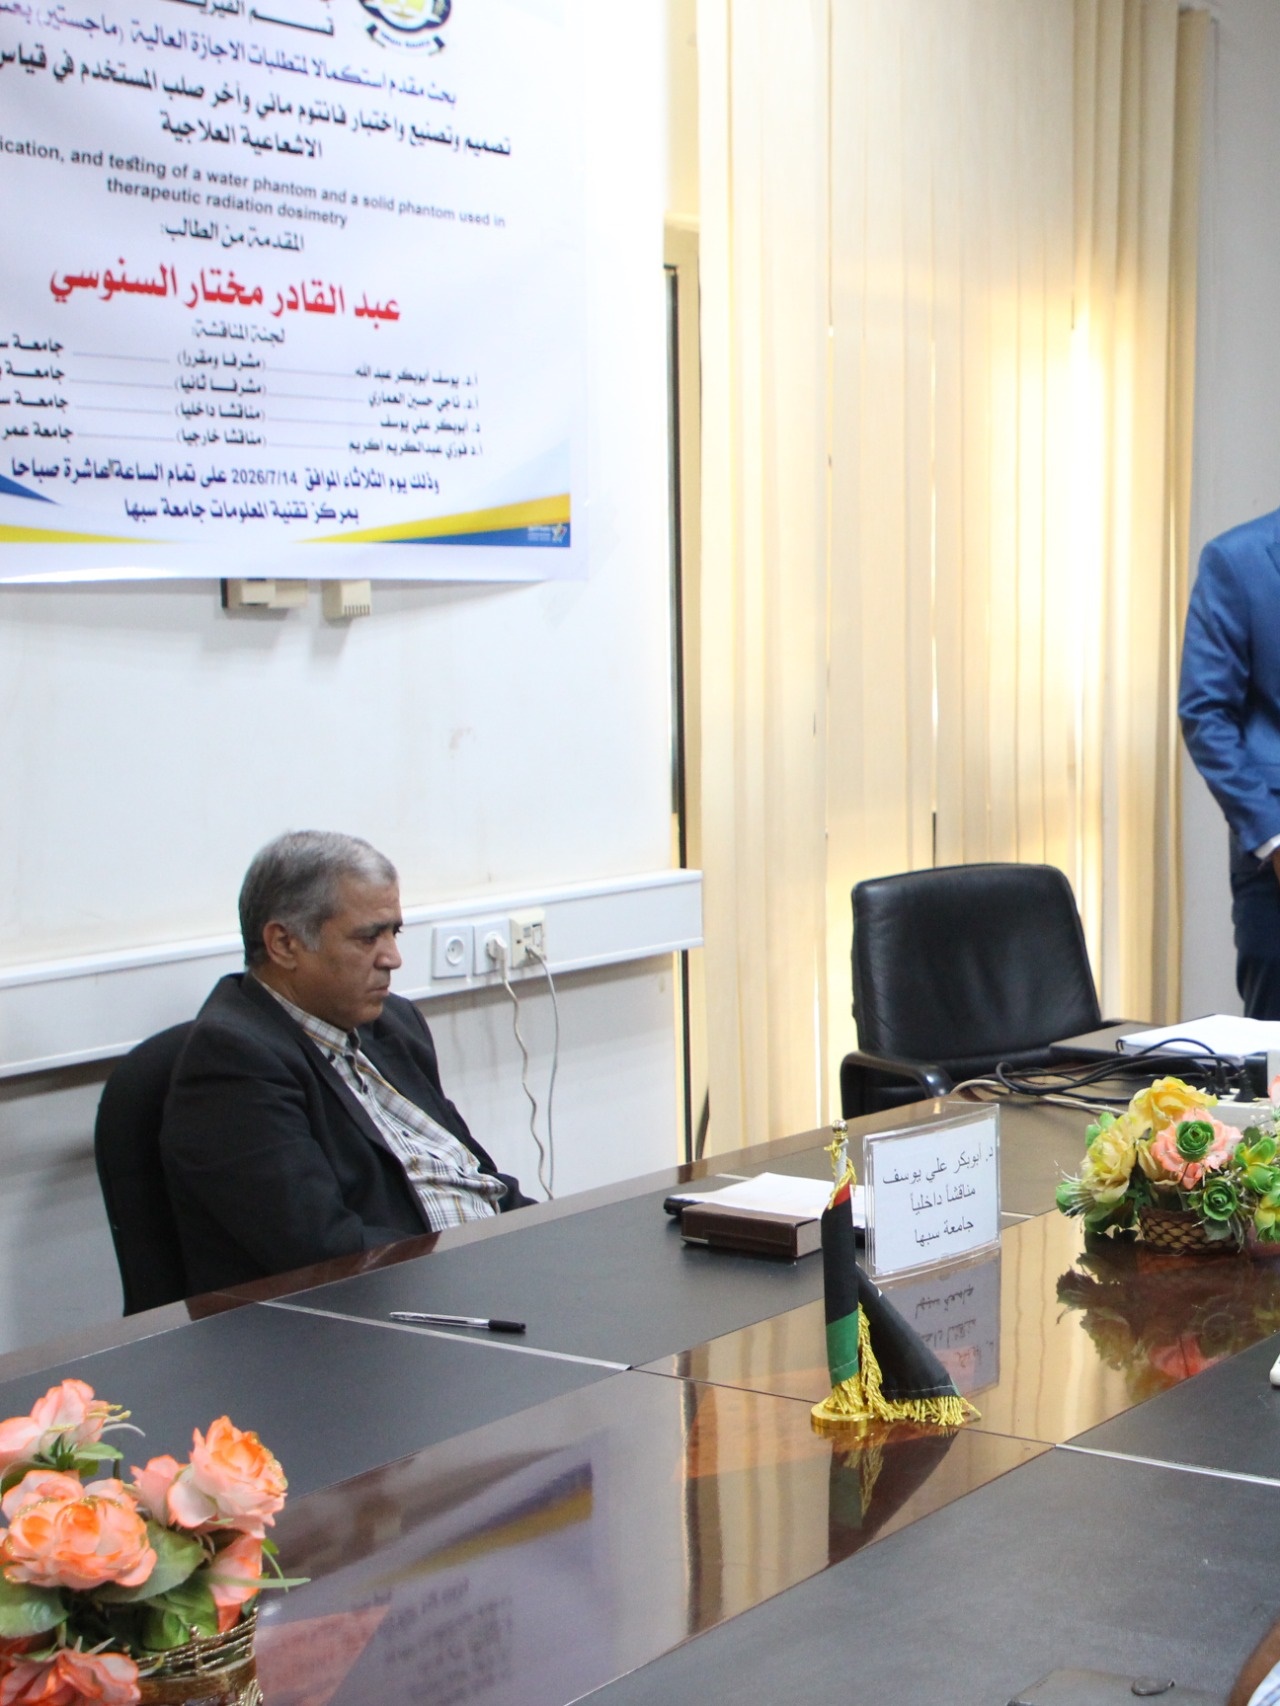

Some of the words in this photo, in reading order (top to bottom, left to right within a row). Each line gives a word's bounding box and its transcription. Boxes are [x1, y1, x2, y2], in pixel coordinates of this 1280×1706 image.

[130, 18, 187, 51] العالية
[52, 48, 75, 83] في
[80, 59, 158, 90] المستخدم
[163, 74, 205, 101] صلب
[389, 76, 425, 97] مقدم
[427, 80, 457, 110] بحث
[299, 99, 347, 125] فانتوم
[160, 110, 236, 145] العلاجية
[351, 108, 404, 142] واختبار
[410, 121, 459, 152] وتصنيع
[464, 128, 511, 156] تصميم
[70, 150, 104, 168] and
[108, 154, 166, 180] testing
[171, 164, 188, 180] of
[192, 169, 202, 182] a
[206, 170, 249, 190] water
[252, 175, 317, 200] phantom
[321, 187, 348, 206] and
[351, 193, 360, 207] a
[363, 194, 396, 213] solid
[398, 200, 456, 222] phantom
[459, 211, 491, 228] used
[494, 213, 506, 228] in
[107, 177, 200, 205] therapeutic
[206, 193, 273, 215] radiation
[277, 201, 348, 230] dosimetry
[221, 224, 245, 249] من
[248, 224, 305, 253] المقدمة
[50, 256, 178, 303] السنوسي
[185, 267, 264, 309] مختار
[272, 278, 345, 318] القادر
[354, 291, 400, 329] عبد
[251, 324, 286, 348] لجنة
[355, 362, 371, 378] الله
[374, 367, 391, 382] عبد
[432, 371, 460, 389] يوسف
[407, 391, 433, 411] حسين
[2, 424, 29, 440] عمر
[33, 421, 73, 444] جامعة
[381, 414, 409, 433] يوسف
[412, 414, 430, 434] علي
[11, 456, 60, 484] صباحا
[114, 459, 164, 482] الساعة
[167, 462, 196, 488] تمام
[200, 465, 227, 488] على
[231, 467, 298, 485] 2026/7/14
[305, 467, 341, 491] الموافق
[344, 465, 386, 489] الثلاثاء
[410, 470, 440, 494] وذلك
[389, 476, 407, 494] يوم
[124, 498, 158, 523] سبها
[161, 497, 206, 523] جامعة
[210, 499, 268, 524] المعلومات
[270, 500, 309, 525] تقنية
[312, 501, 359, 526] بمركز
[882, 1168, 922, 1185] يوسف
[925, 1157, 948, 1183] علي
[943, 1216, 974, 1235] جامعة
[914, 1229, 940, 1248] سبها
